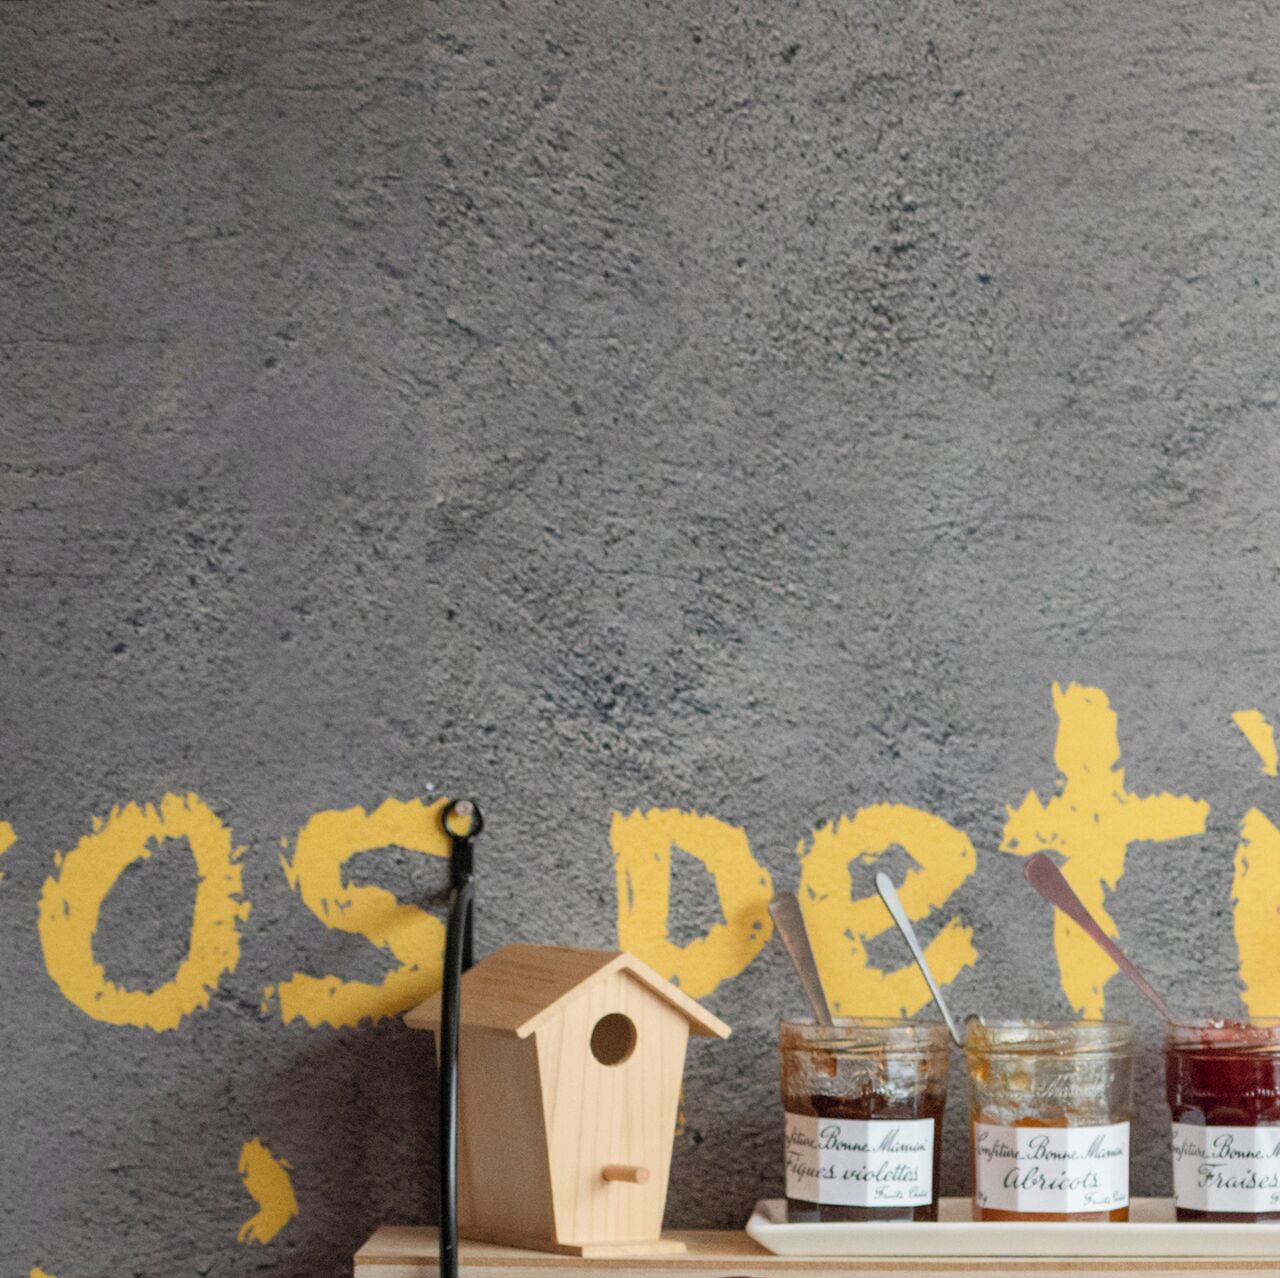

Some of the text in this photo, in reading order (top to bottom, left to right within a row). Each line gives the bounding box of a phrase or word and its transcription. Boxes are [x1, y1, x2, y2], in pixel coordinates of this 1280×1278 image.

[0, 790, 455, 1032] os
[818, 1126, 870, 1152] Bonne
[1025, 1135, 1079, 1161] Bonne
[1210, 1135, 1264, 1160] Bonne
[843, 1161, 918, 1182] violettes
[1198, 1163, 1280, 1190] Fraises
